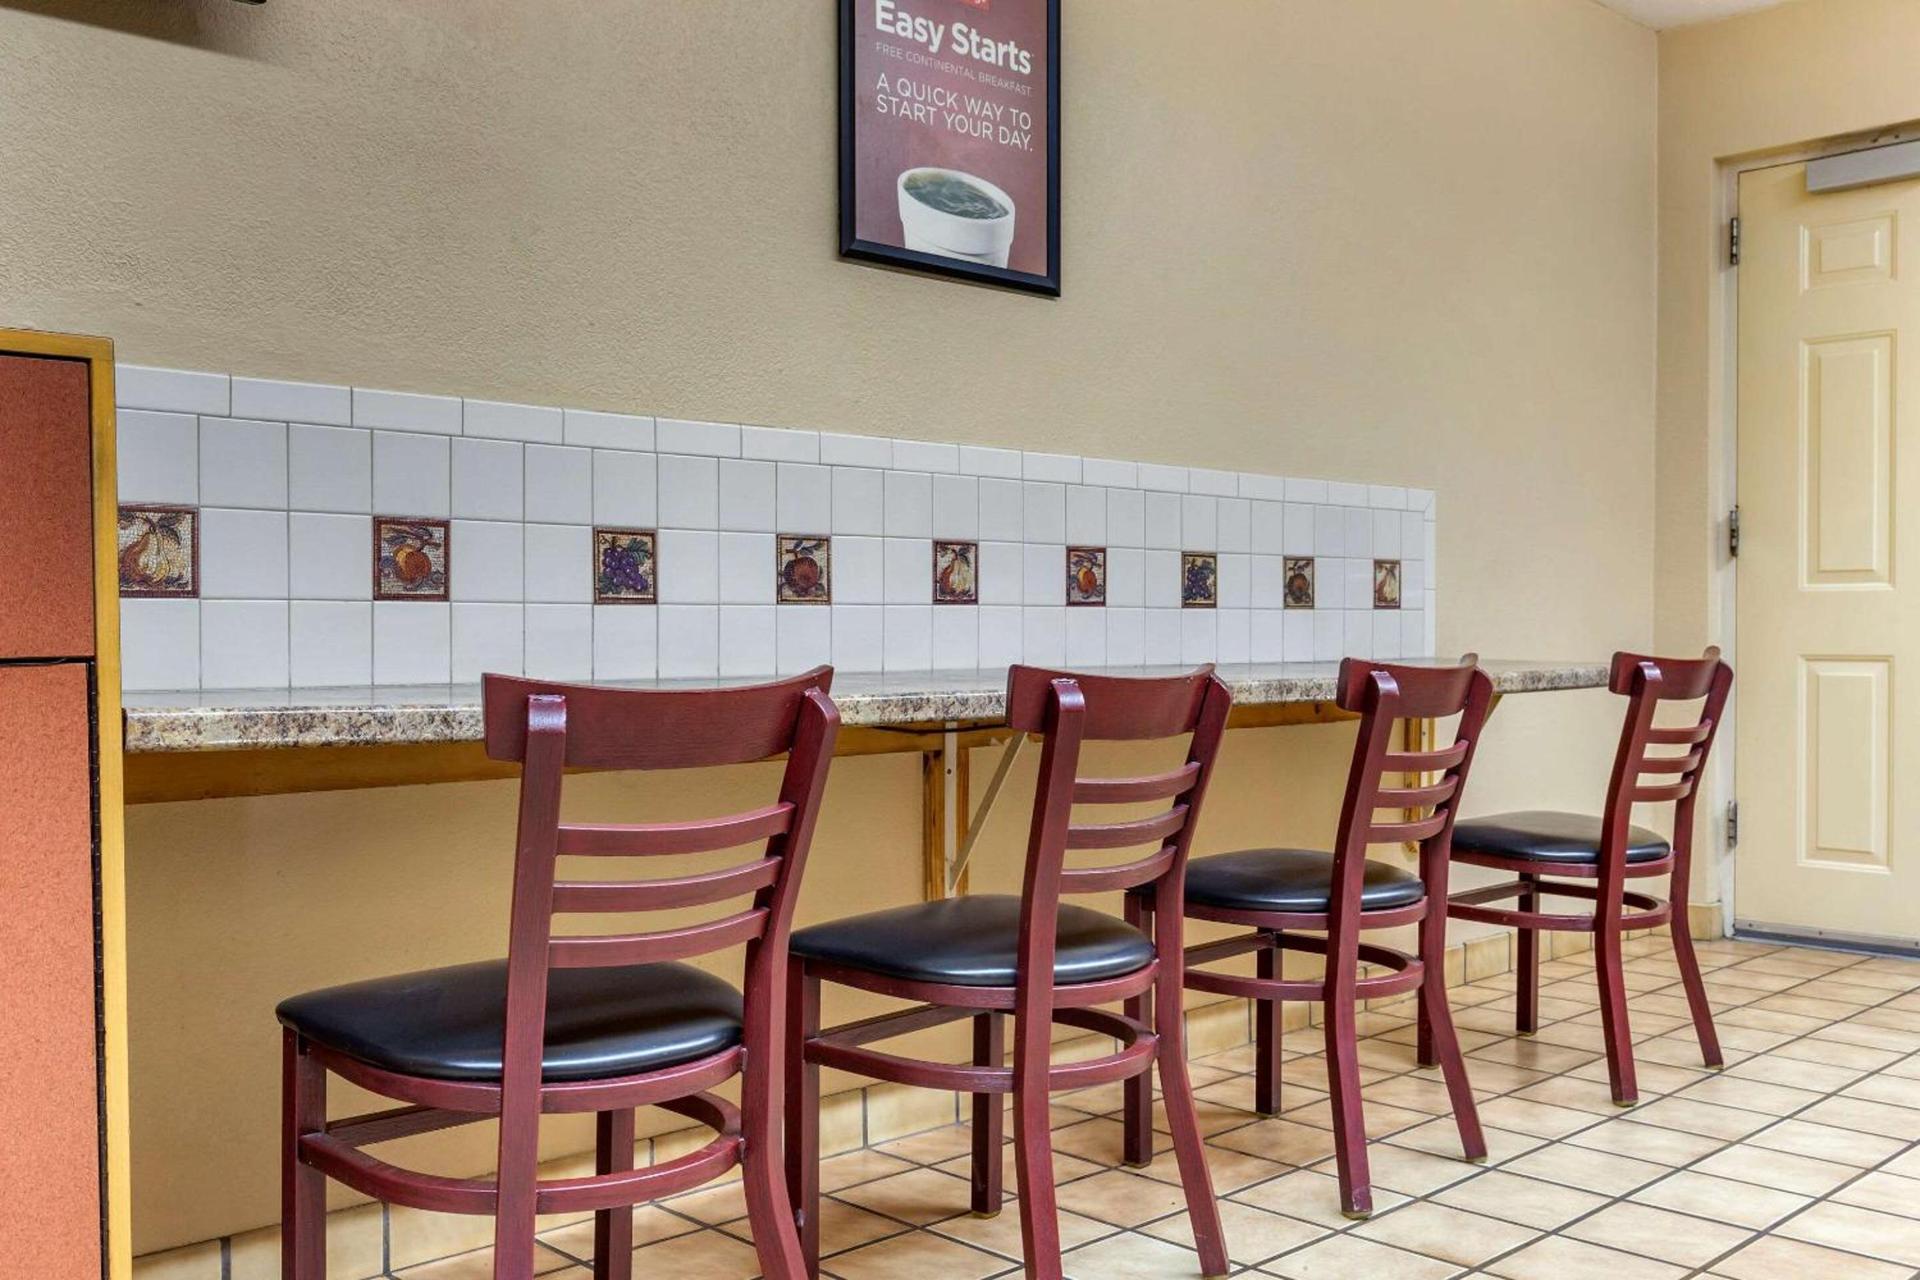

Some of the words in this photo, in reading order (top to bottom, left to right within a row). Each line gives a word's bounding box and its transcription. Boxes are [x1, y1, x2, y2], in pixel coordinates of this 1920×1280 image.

[875, 0, 944, 53] Easy
[952, 22, 1031, 75] Starts
[876, 42, 903, 60] FREE
[905, 49, 975, 81] CONTINENTAL
[876, 72, 890, 93] A
[897, 78, 958, 111] QUICK
[964, 95, 1003, 122] WAY
[1010, 108, 1031, 130] TO
[876, 94, 937, 126] START
[943, 111, 993, 142] YOUR
[999, 126, 1033, 152] DAY.
